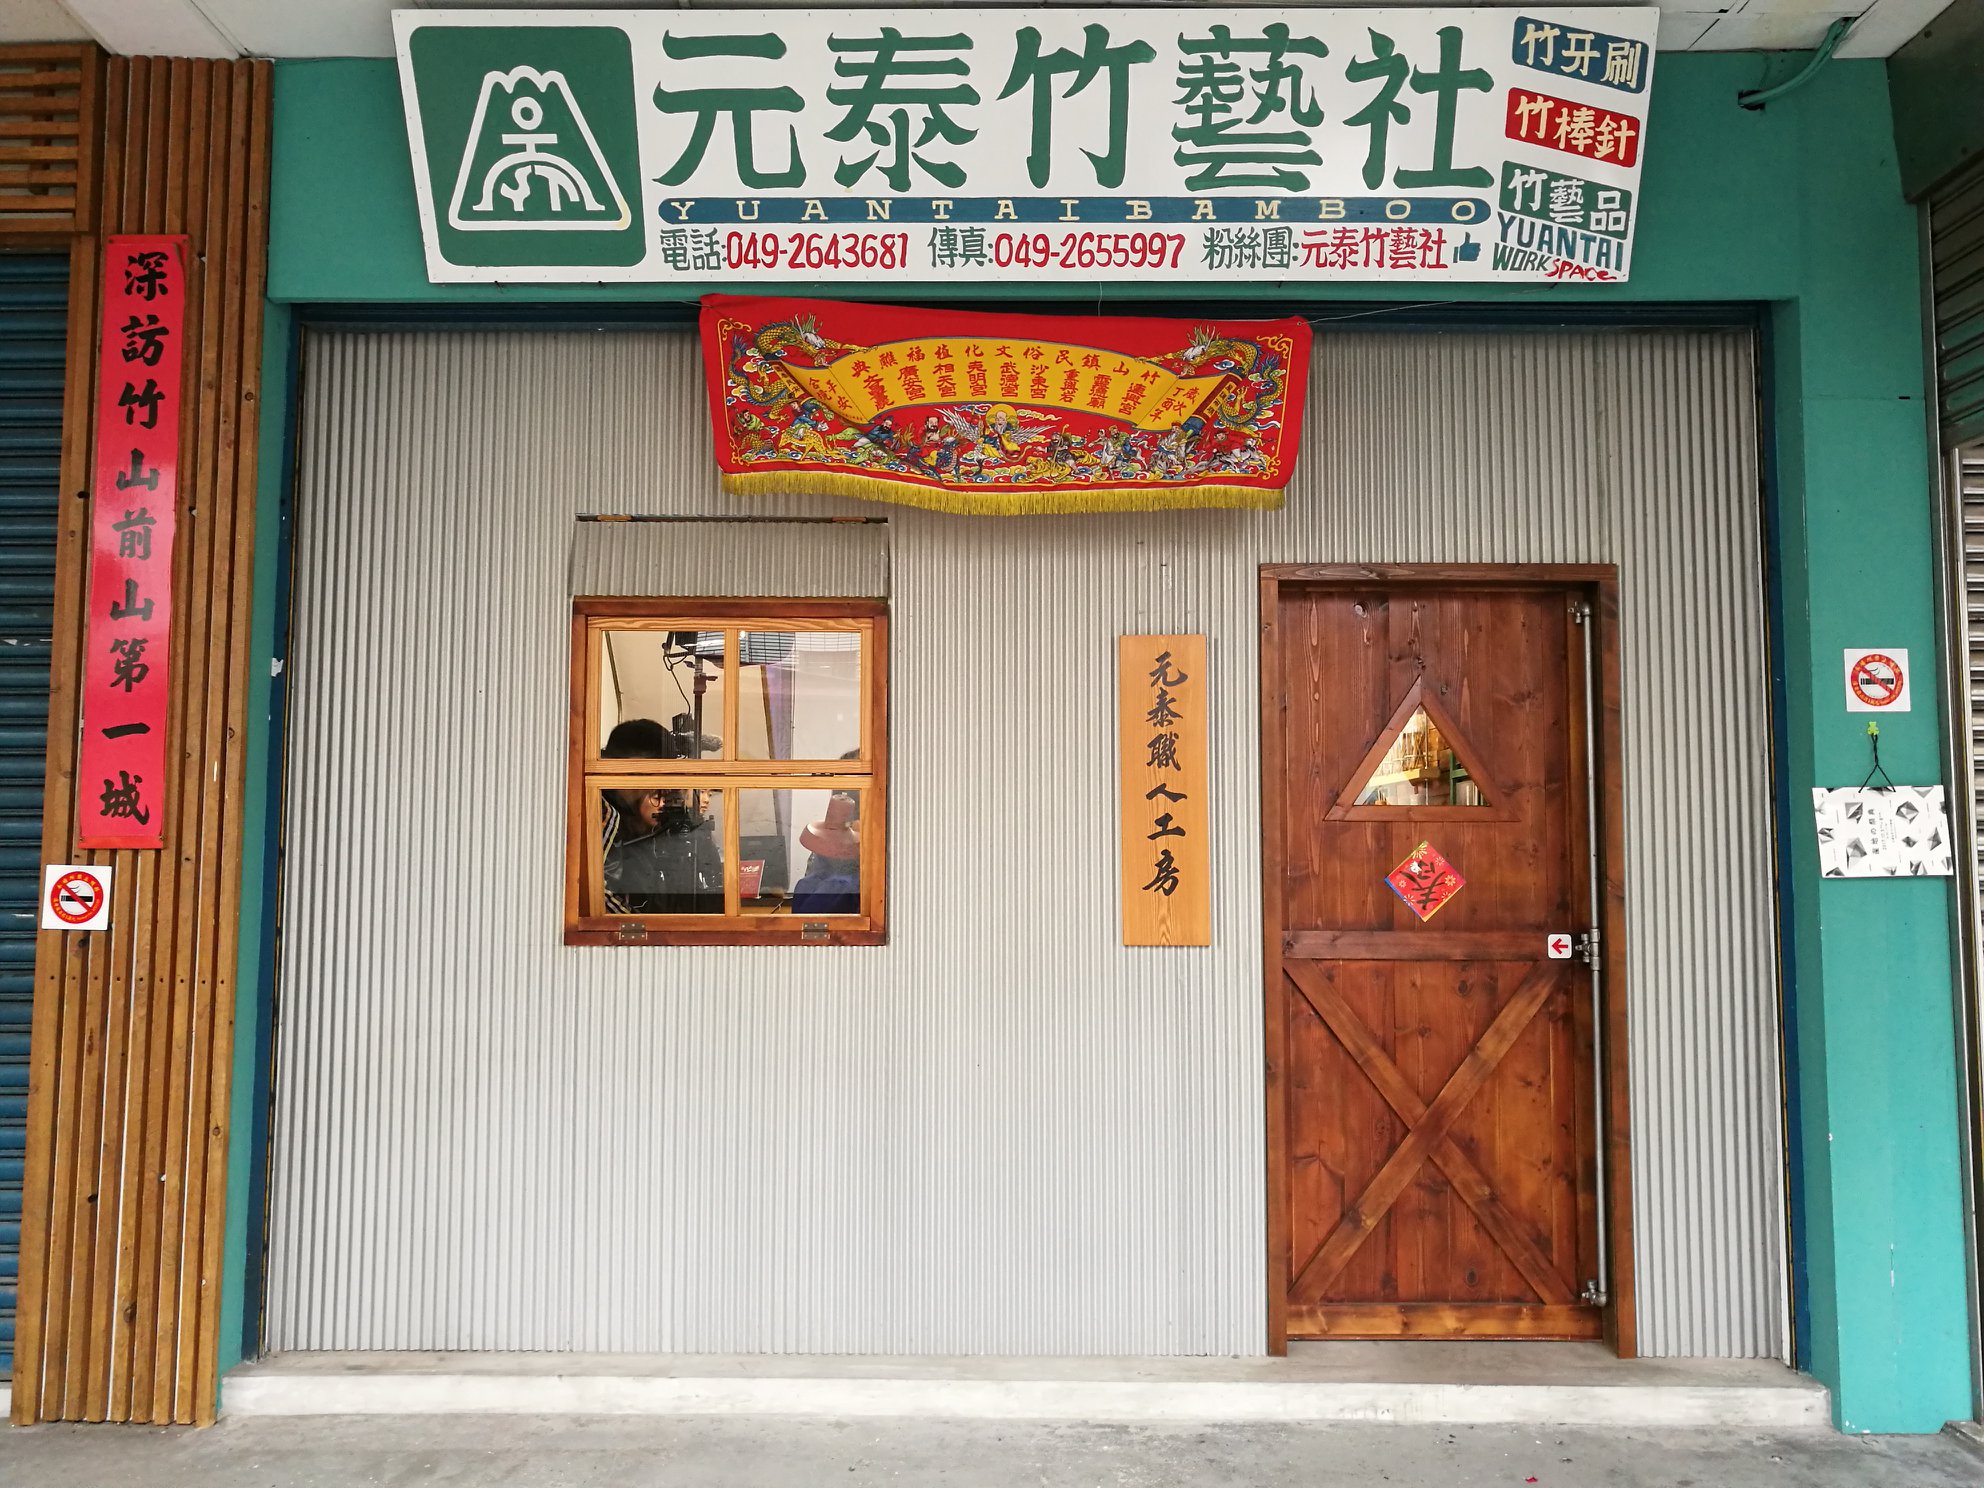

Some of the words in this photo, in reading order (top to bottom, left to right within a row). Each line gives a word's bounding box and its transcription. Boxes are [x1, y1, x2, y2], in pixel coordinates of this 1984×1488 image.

[652, 23, 1494, 193] 元泰竹藝社
[1515, 95, 1636, 160] 竹棒針
[1508, 169, 1626, 231] 竹藝品
[1492, 242, 1552, 271] WORK
[1498, 211, 1624, 272] YUANTAI
[100, 252, 170, 826] 深訪竹山前山第一城
[1142, 651, 1188, 896] 元泰職人工房
